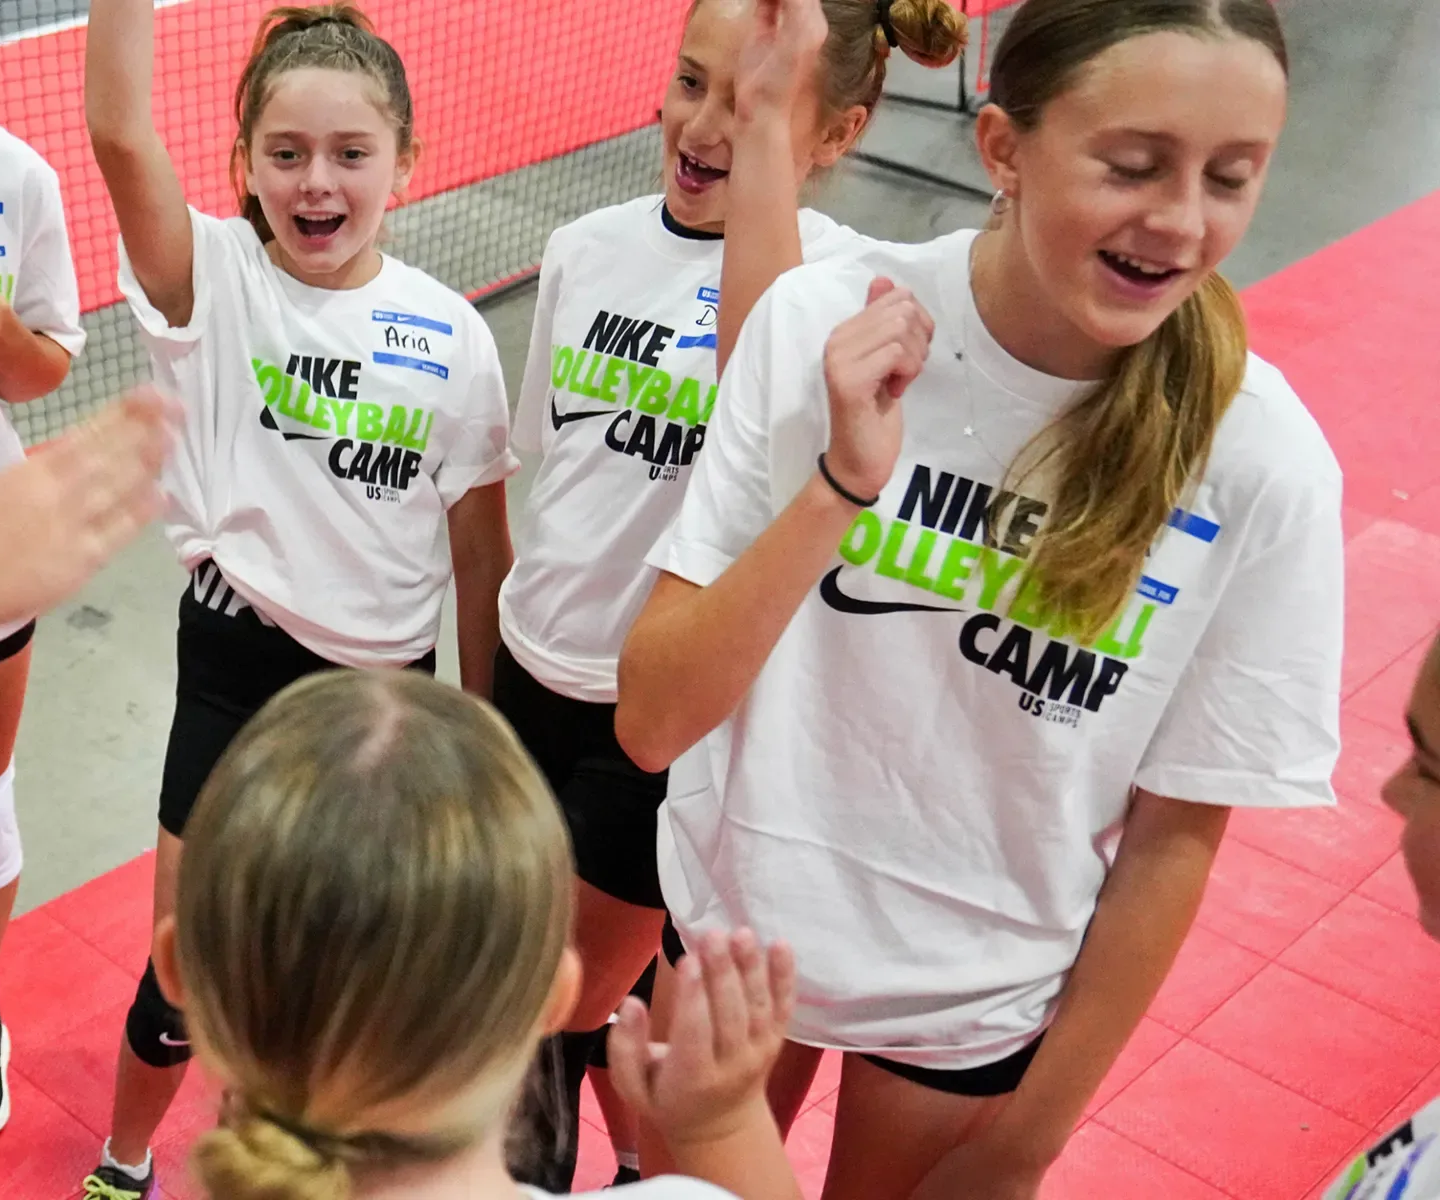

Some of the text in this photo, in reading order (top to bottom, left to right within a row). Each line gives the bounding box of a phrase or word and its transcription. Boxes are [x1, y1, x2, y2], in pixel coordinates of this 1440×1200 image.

[384, 325, 431, 355] Aria
[582, 310, 675, 367] NIKE
[251, 357, 435, 453] OLLEYBALL
[328, 438, 423, 490] CAMP
[604, 408, 707, 466] CAMP
[366, 485, 382, 500] US
[897, 464, 1048, 559] NIKE
[959, 613, 1129, 712] CAMP
[1019, 691, 1046, 716] US
